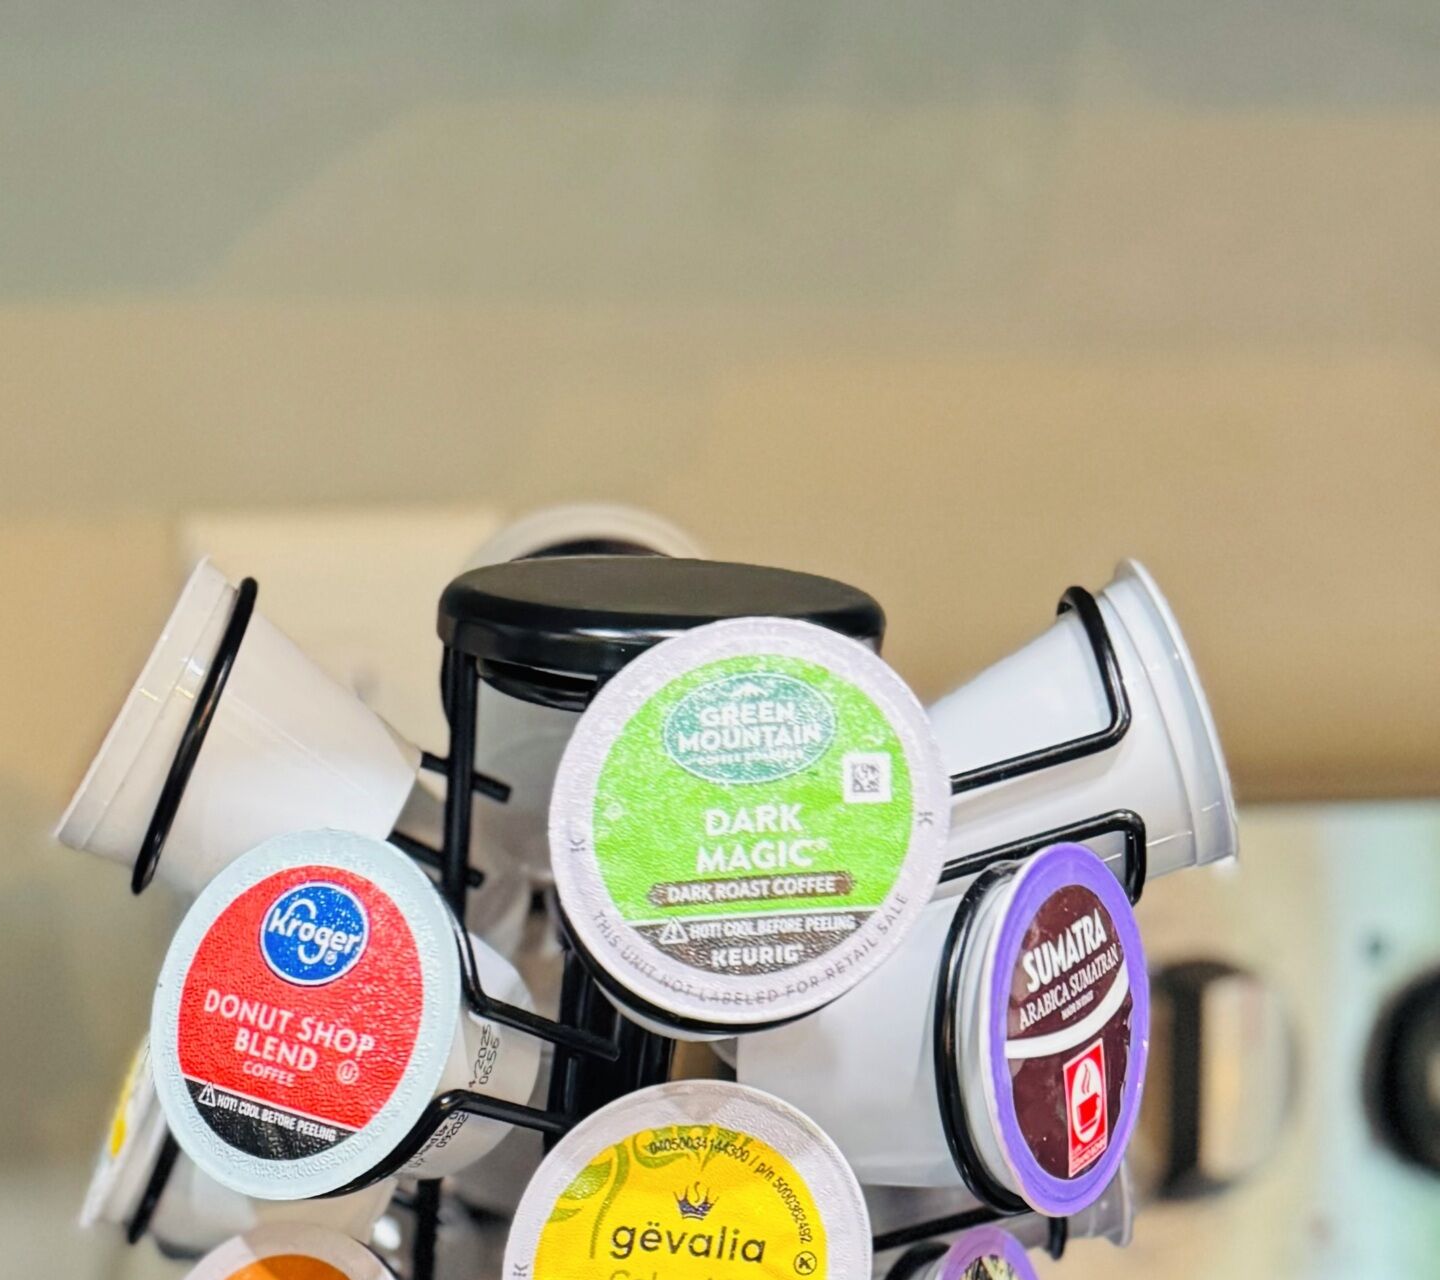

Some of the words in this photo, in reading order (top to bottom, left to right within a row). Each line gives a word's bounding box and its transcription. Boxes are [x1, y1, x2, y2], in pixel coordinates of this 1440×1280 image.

[699, 700, 795, 727] GREEN
[677, 722, 821, 752] MOUNTAIN
[704, 803, 802, 836] DARK
[696, 839, 813, 875] MAGIC
[666, 885, 712, 903] DARK
[714, 879, 770, 899] ROAST
[772, 875, 836, 895] COFFEE
[269, 899, 360, 964] Kroger
[1023, 907, 1108, 993] SUMATRA
[711, 945, 800, 967] KEURIG
[1019, 981, 1071, 1031] ARABICA
[1069, 942, 1120, 998] SUMATRAN
[204, 989, 294, 1034] DONUT
[297, 1016, 375, 1058] SHOP
[234, 1028, 317, 1071] BLEND
[242, 1060, 296, 1087] COFFEE
[217, 1094, 238, 1111] HOT!
[238, 1102, 260, 1119] COOL
[260, 1109, 296, 1130] BEFORE
[296, 1119, 338, 1142] PEELING
[608, 1221, 766, 1264] gëvalia
